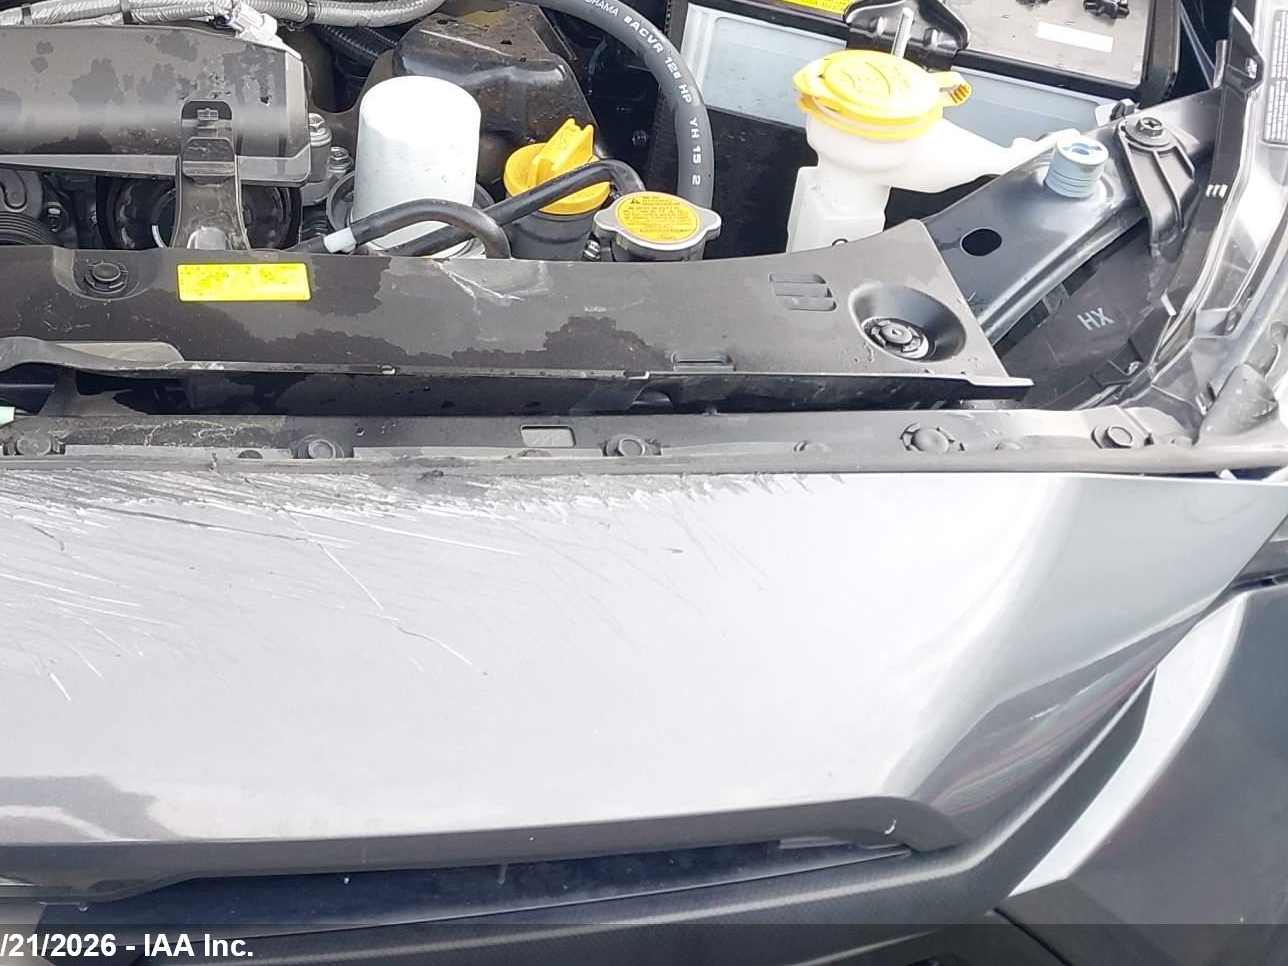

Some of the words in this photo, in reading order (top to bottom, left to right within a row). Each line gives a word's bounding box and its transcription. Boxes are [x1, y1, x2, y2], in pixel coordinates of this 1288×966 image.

[678, 84, 693, 104] HP
[689, 117, 700, 139] YH
[692, 146, 702, 164] 15
[1077, 307, 1114, 330] HX
